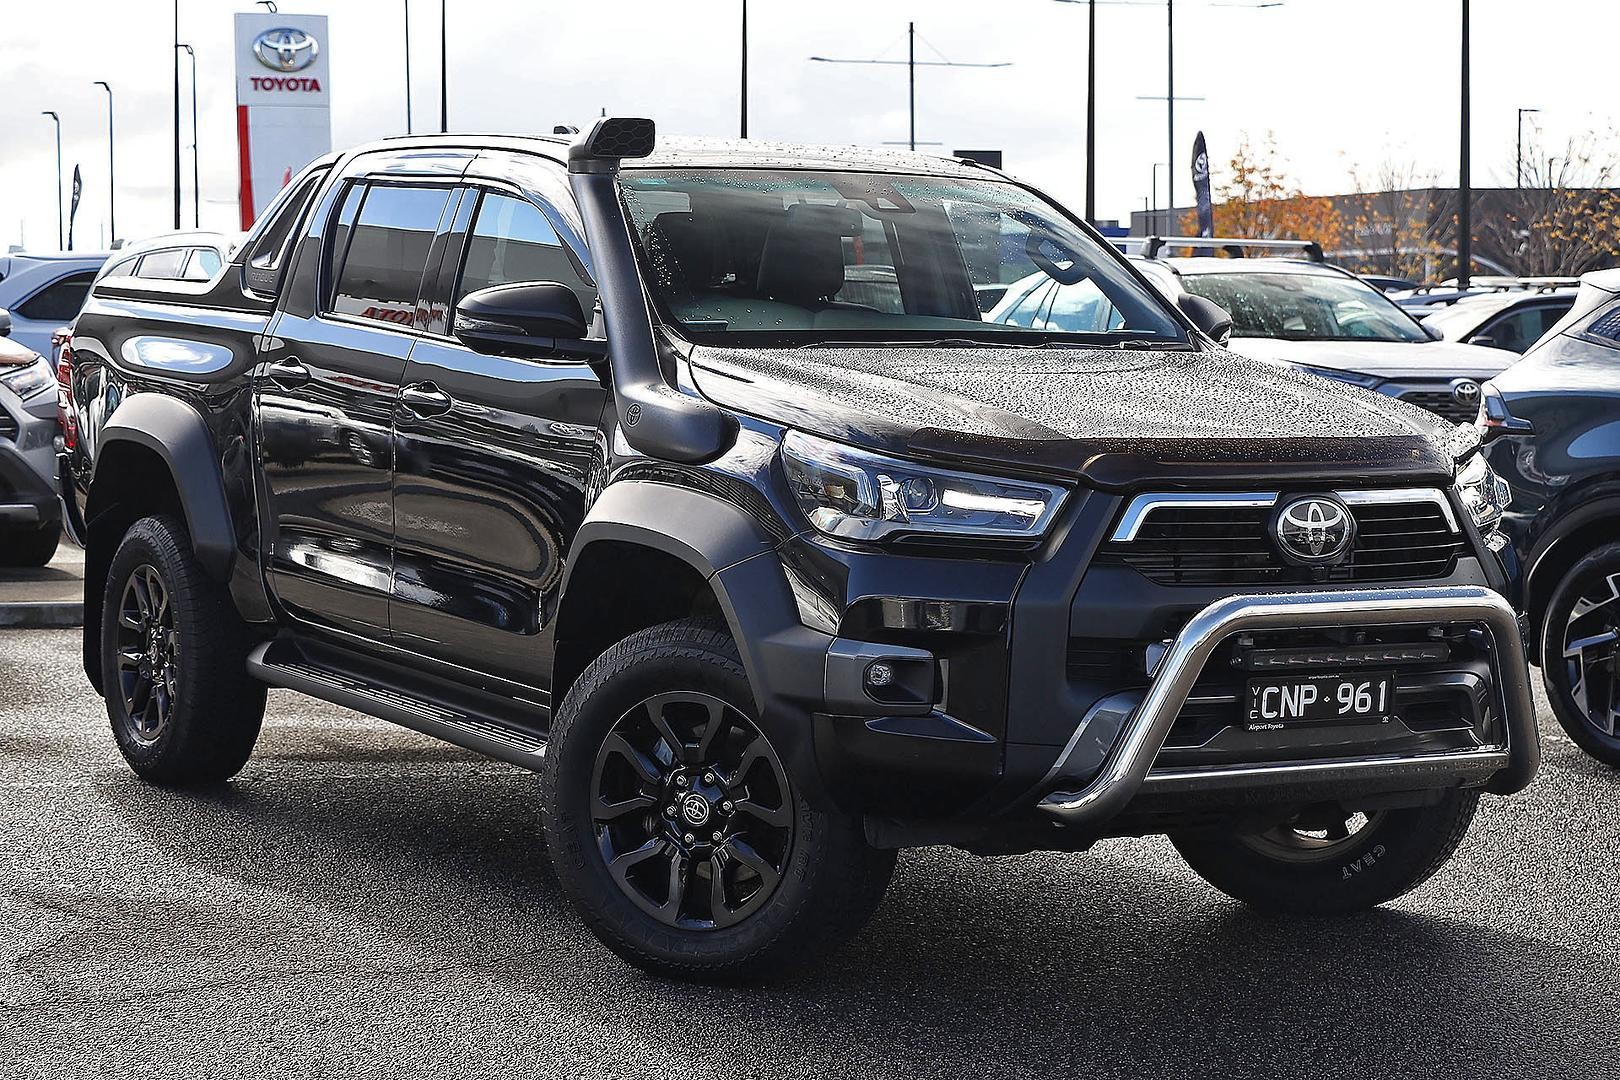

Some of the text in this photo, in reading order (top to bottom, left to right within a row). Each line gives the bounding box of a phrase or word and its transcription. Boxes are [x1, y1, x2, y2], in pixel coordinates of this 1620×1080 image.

[250, 77, 321, 92] TOYOTA
[1261, 680, 1387, 719] CNP 961
[1248, 723, 1284, 731] Airport Toyota
[1341, 844, 1386, 880] CEAT
